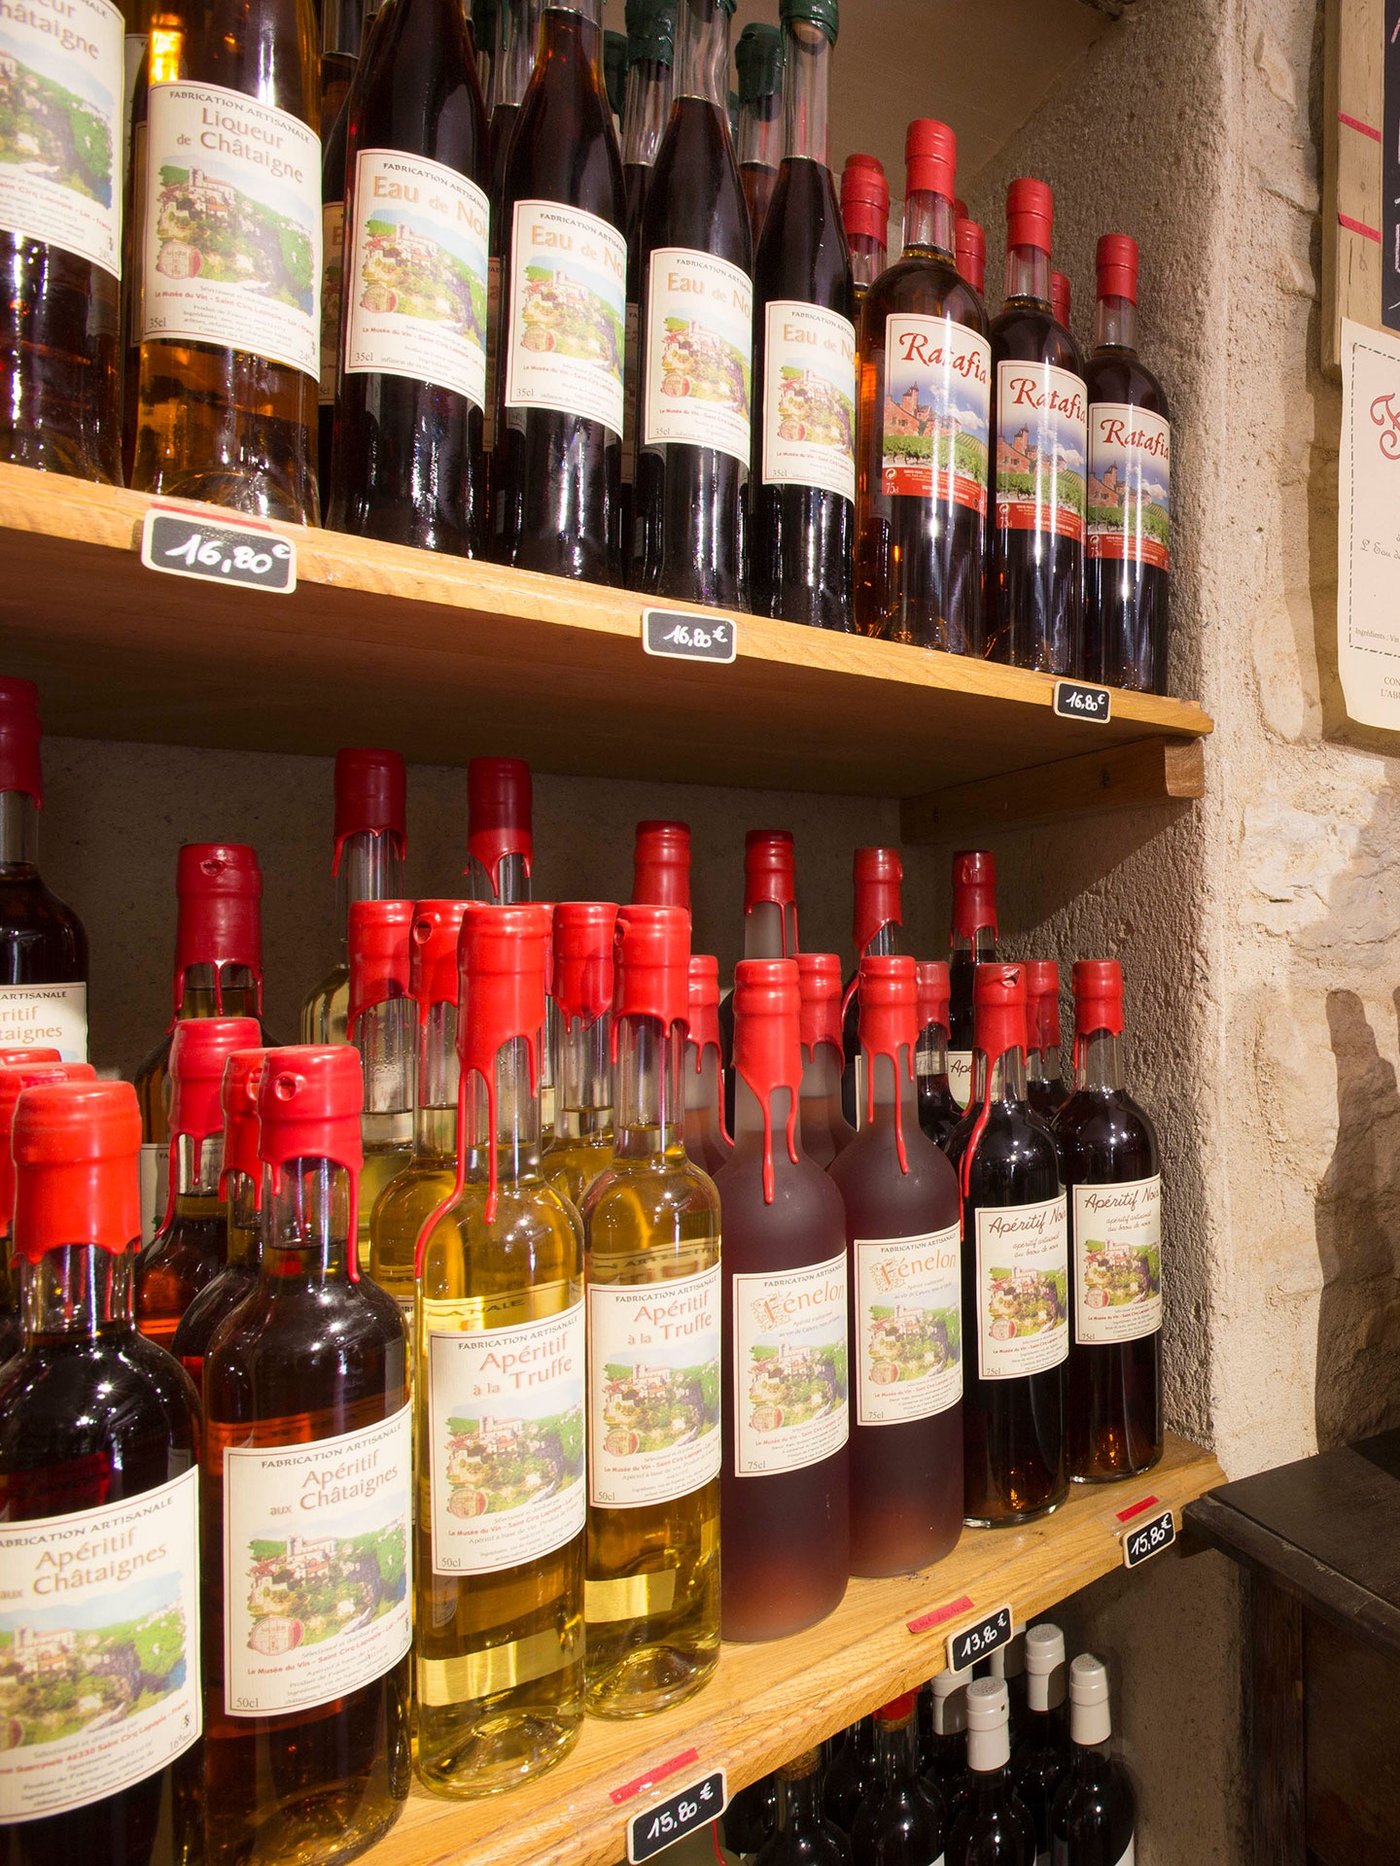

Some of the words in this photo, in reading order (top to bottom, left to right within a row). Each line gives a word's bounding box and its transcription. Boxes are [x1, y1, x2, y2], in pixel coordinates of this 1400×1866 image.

[170, 90, 244, 112] FABRICATION
[247, 107, 311, 144] ARTISANALE
[202, 107, 284, 149] Liqueur
[177, 133, 192, 146] de
[201, 131, 304, 184] Châtaigne
[384, 162, 448, 186] FABRICATION
[373, 174, 419, 203] Eau
[430, 196, 449, 214] de
[531, 223, 573, 252] Eau
[540, 212, 598, 235] FABRICATION
[677, 258, 728, 276] FABRICATION
[667, 271, 705, 295] Eau
[149, 317, 167, 328] 35cl
[783, 323, 817, 346] Eau
[355, 352, 374, 362] 35cl
[899, 331, 987, 385] Ratafia
[516, 388, 534, 398] 35cl
[1010, 377, 1087, 425] Ratafia
[655, 427, 671, 437] 35cl
[1100, 418, 1169, 461] Ratafia
[1373, 542, 1391, 558] Eau
[1354, 627, 1387, 640] Ingrédients
[1389, 633, 1400, 643] Vin
[1065, 691, 1106, 712] 16,80€
[1, 991, 67, 1000] ARTISANALE
[1085, 1188, 1138, 1215] Apéritif
[989, 1210, 1047, 1239] Apéritif
[881, 1242, 926, 1254] FABRICATION
[764, 1273, 815, 1288] FABRICATION
[869, 1249, 957, 1294] Fénelon
[616, 1290, 676, 1303] FABRICATION
[676, 1274, 718, 1296] ARTISANALE
[633, 1288, 710, 1326] Apéritif
[752, 1279, 845, 1332] Fénelon
[458, 1334, 528, 1350] FABRICATION
[530, 1315, 578, 1339] ARTISANALE
[628, 1334, 636, 1345] à
[640, 1332, 652, 1344] la
[659, 1313, 712, 1340] Truffe
[480, 1331, 569, 1375] Apéritif
[473, 1384, 481, 1396] à
[488, 1382, 500, 1393] la
[509, 1356, 572, 1389] Truffe
[868, 1410, 884, 1419] 75cl
[262, 1450, 343, 1468] FABRICATION
[346, 1423, 402, 1453] ARTISANALE
[301, 1449, 380, 1489] Apéritif
[748, 1460, 766, 1470] 75cl
[269, 1505, 292, 1516] aux
[300, 1464, 398, 1510] Châtaignes
[598, 1491, 616, 1502] 50cl
[90, 1496, 174, 1533] ARTISANALE
[457, 1528, 479, 1537] Musée
[1130, 1513, 1172, 1555] 15,80€
[35, 1526, 137, 1573] Apéritif
[441, 1557, 461, 1568] 50cl
[33, 1543, 168, 1595] Châtaignes
[257, 1666, 283, 1675] Musée
[236, 1697, 260, 1709] 50cl
